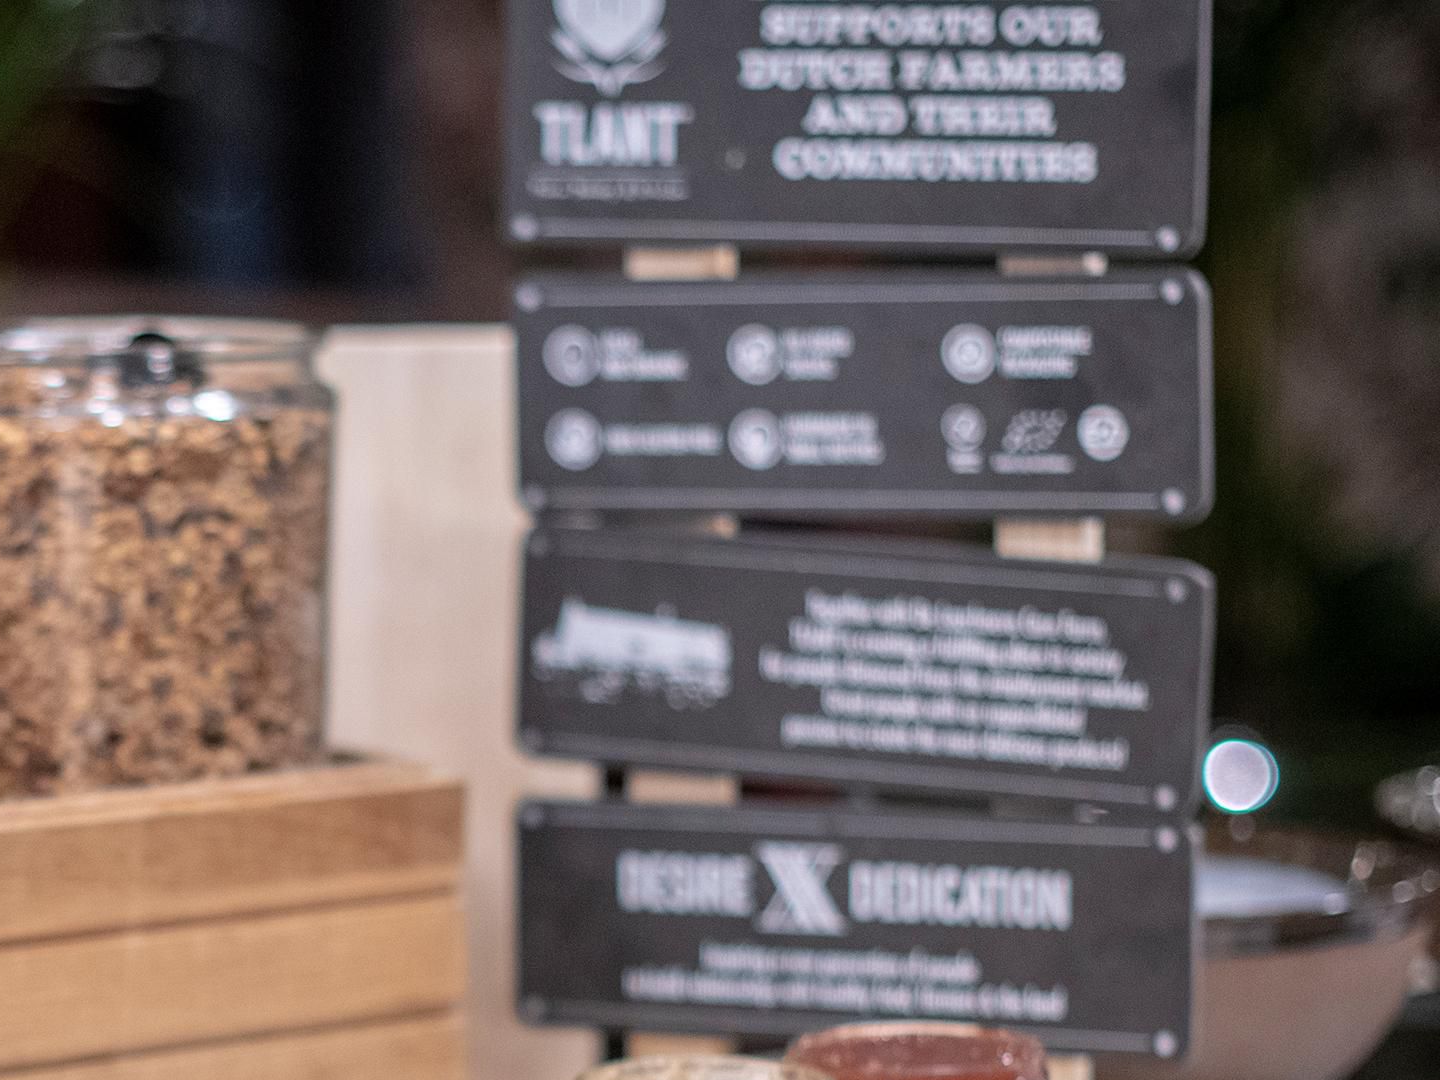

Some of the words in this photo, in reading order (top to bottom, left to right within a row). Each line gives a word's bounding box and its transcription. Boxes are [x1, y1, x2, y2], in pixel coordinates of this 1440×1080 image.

[760, 5, 996, 46] SUPPORTS
[998, 5, 1103, 47] OUR
[738, 50, 893, 90] DUTCH
[900, 52, 1126, 92] FARMERS
[803, 97, 907, 136] AND
[773, 138, 1098, 181] COMMUNITIES
[848, 861, 1072, 931] DEDICATION
